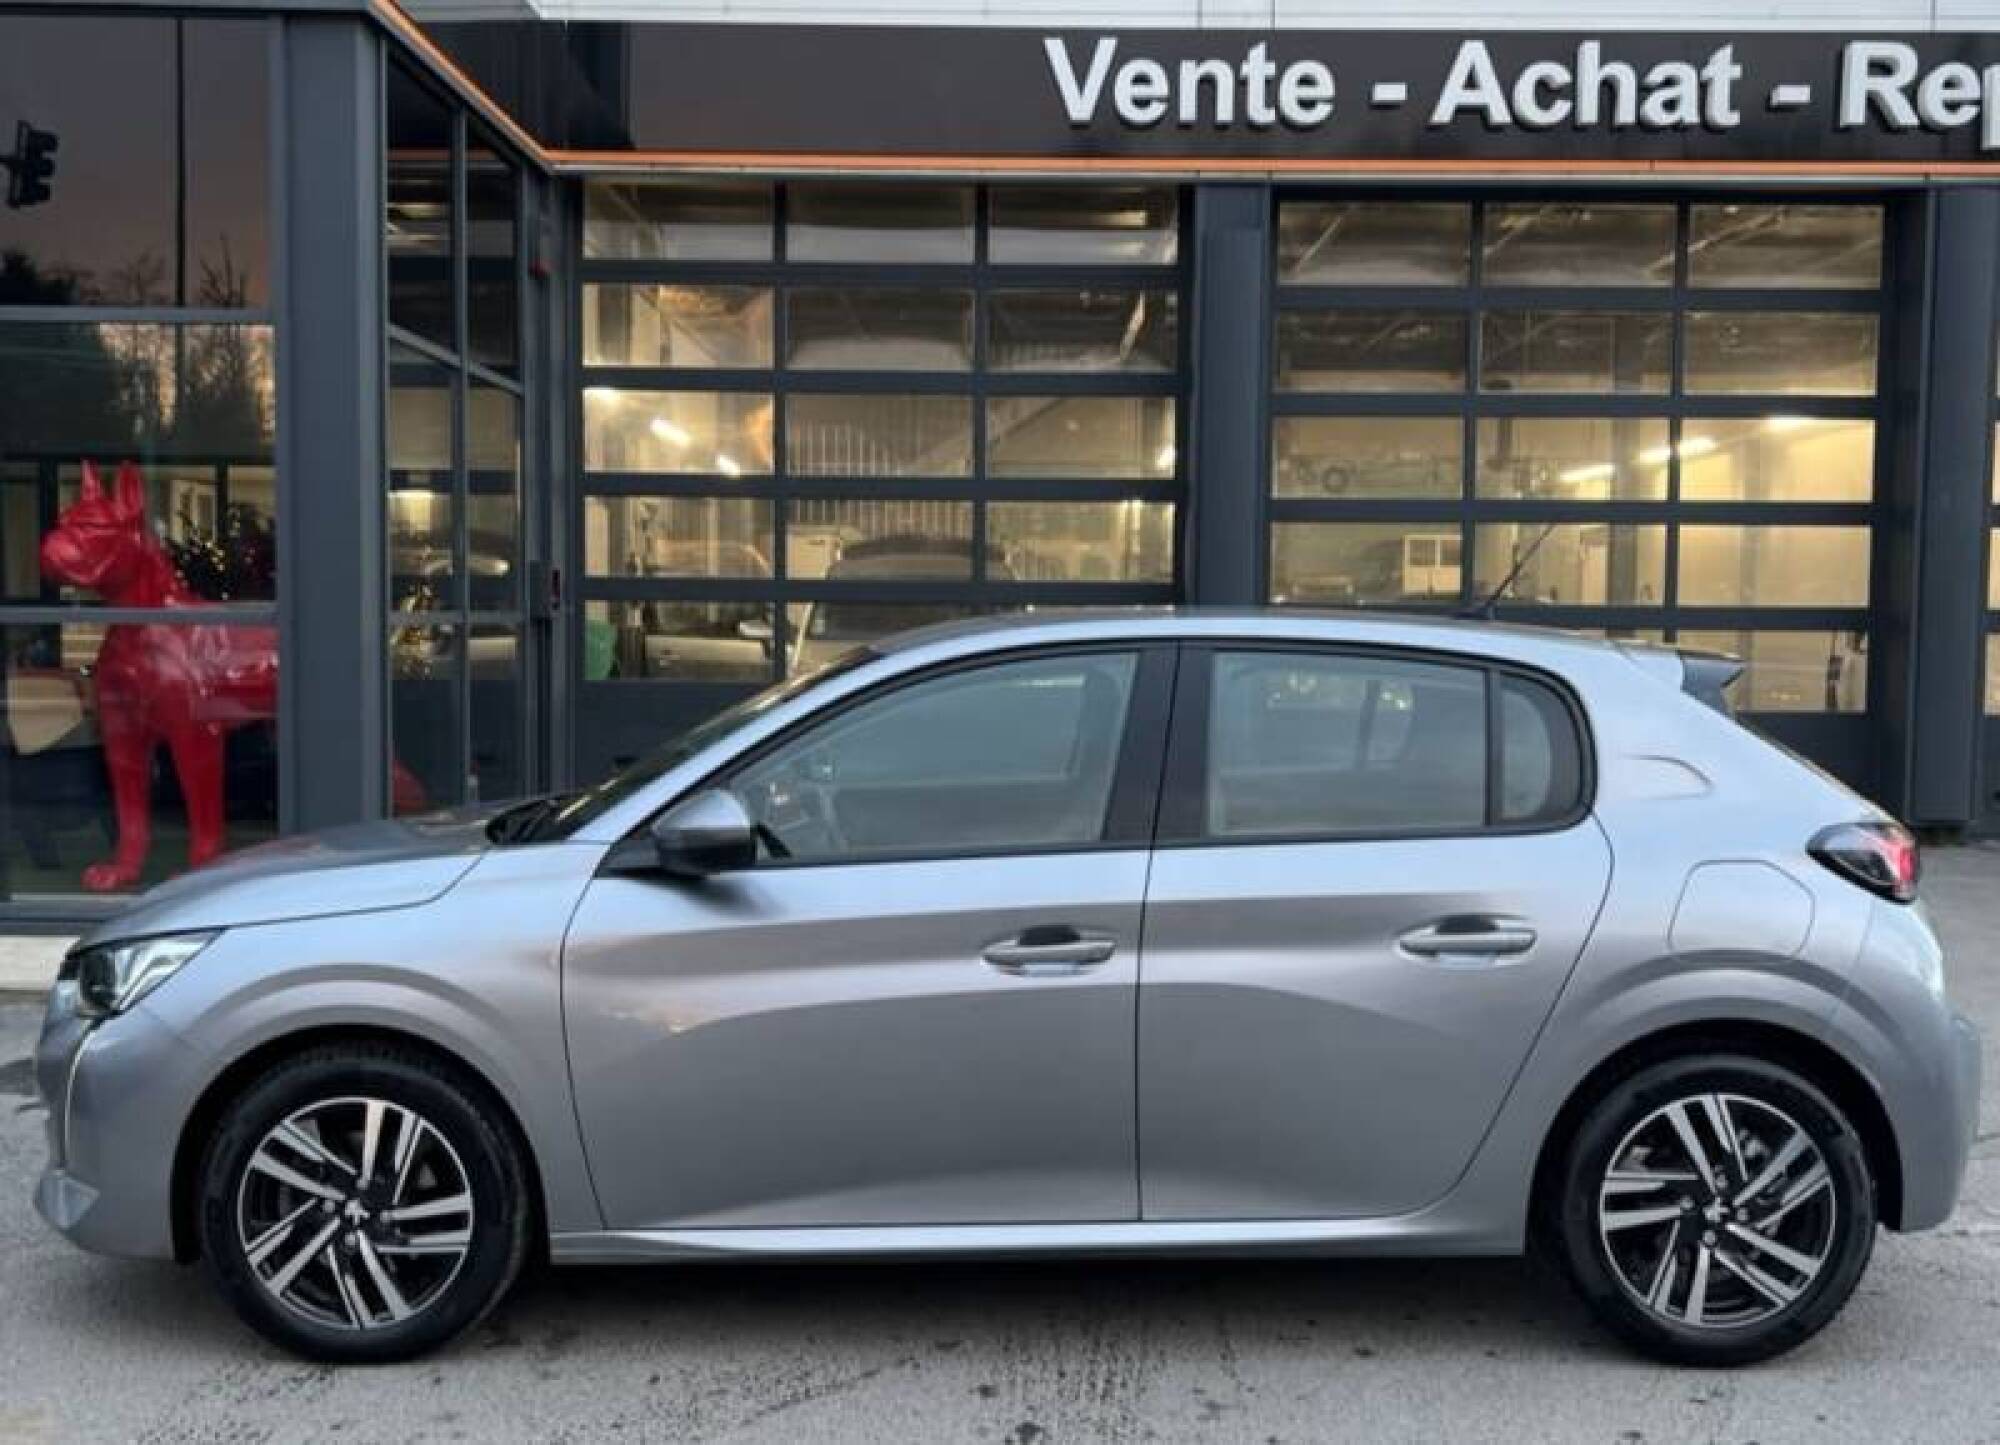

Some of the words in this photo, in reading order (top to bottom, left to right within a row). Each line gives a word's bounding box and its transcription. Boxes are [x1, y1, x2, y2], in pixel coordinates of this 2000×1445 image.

[1044, 37, 1335, 126] Vente
[1371, 81, 1407, 104] -
[1432, 38, 1741, 128] Achat
[1772, 82, 1811, 105] -
